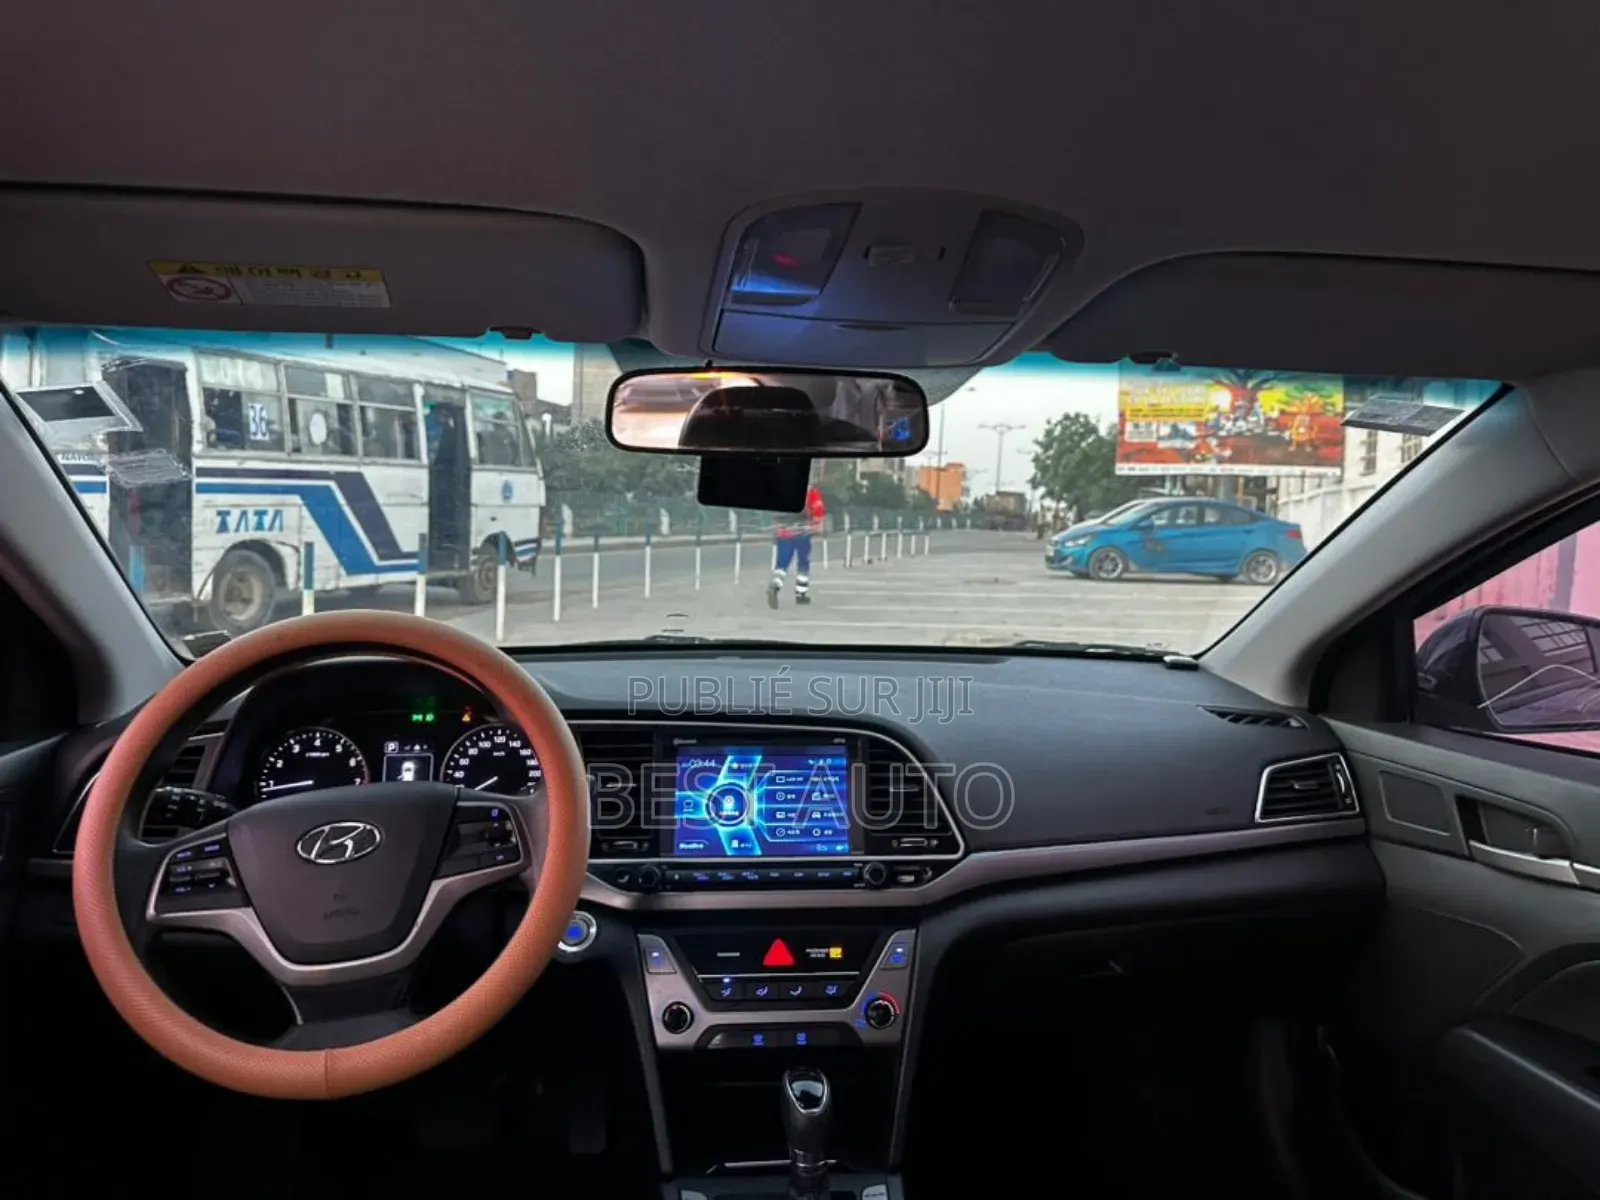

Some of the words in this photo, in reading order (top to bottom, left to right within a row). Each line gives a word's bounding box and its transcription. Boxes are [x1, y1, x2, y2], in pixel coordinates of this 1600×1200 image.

[248, 404, 268, 438] 36
[215, 509, 284, 533] TATA
[493, 735, 506, 743] 120
